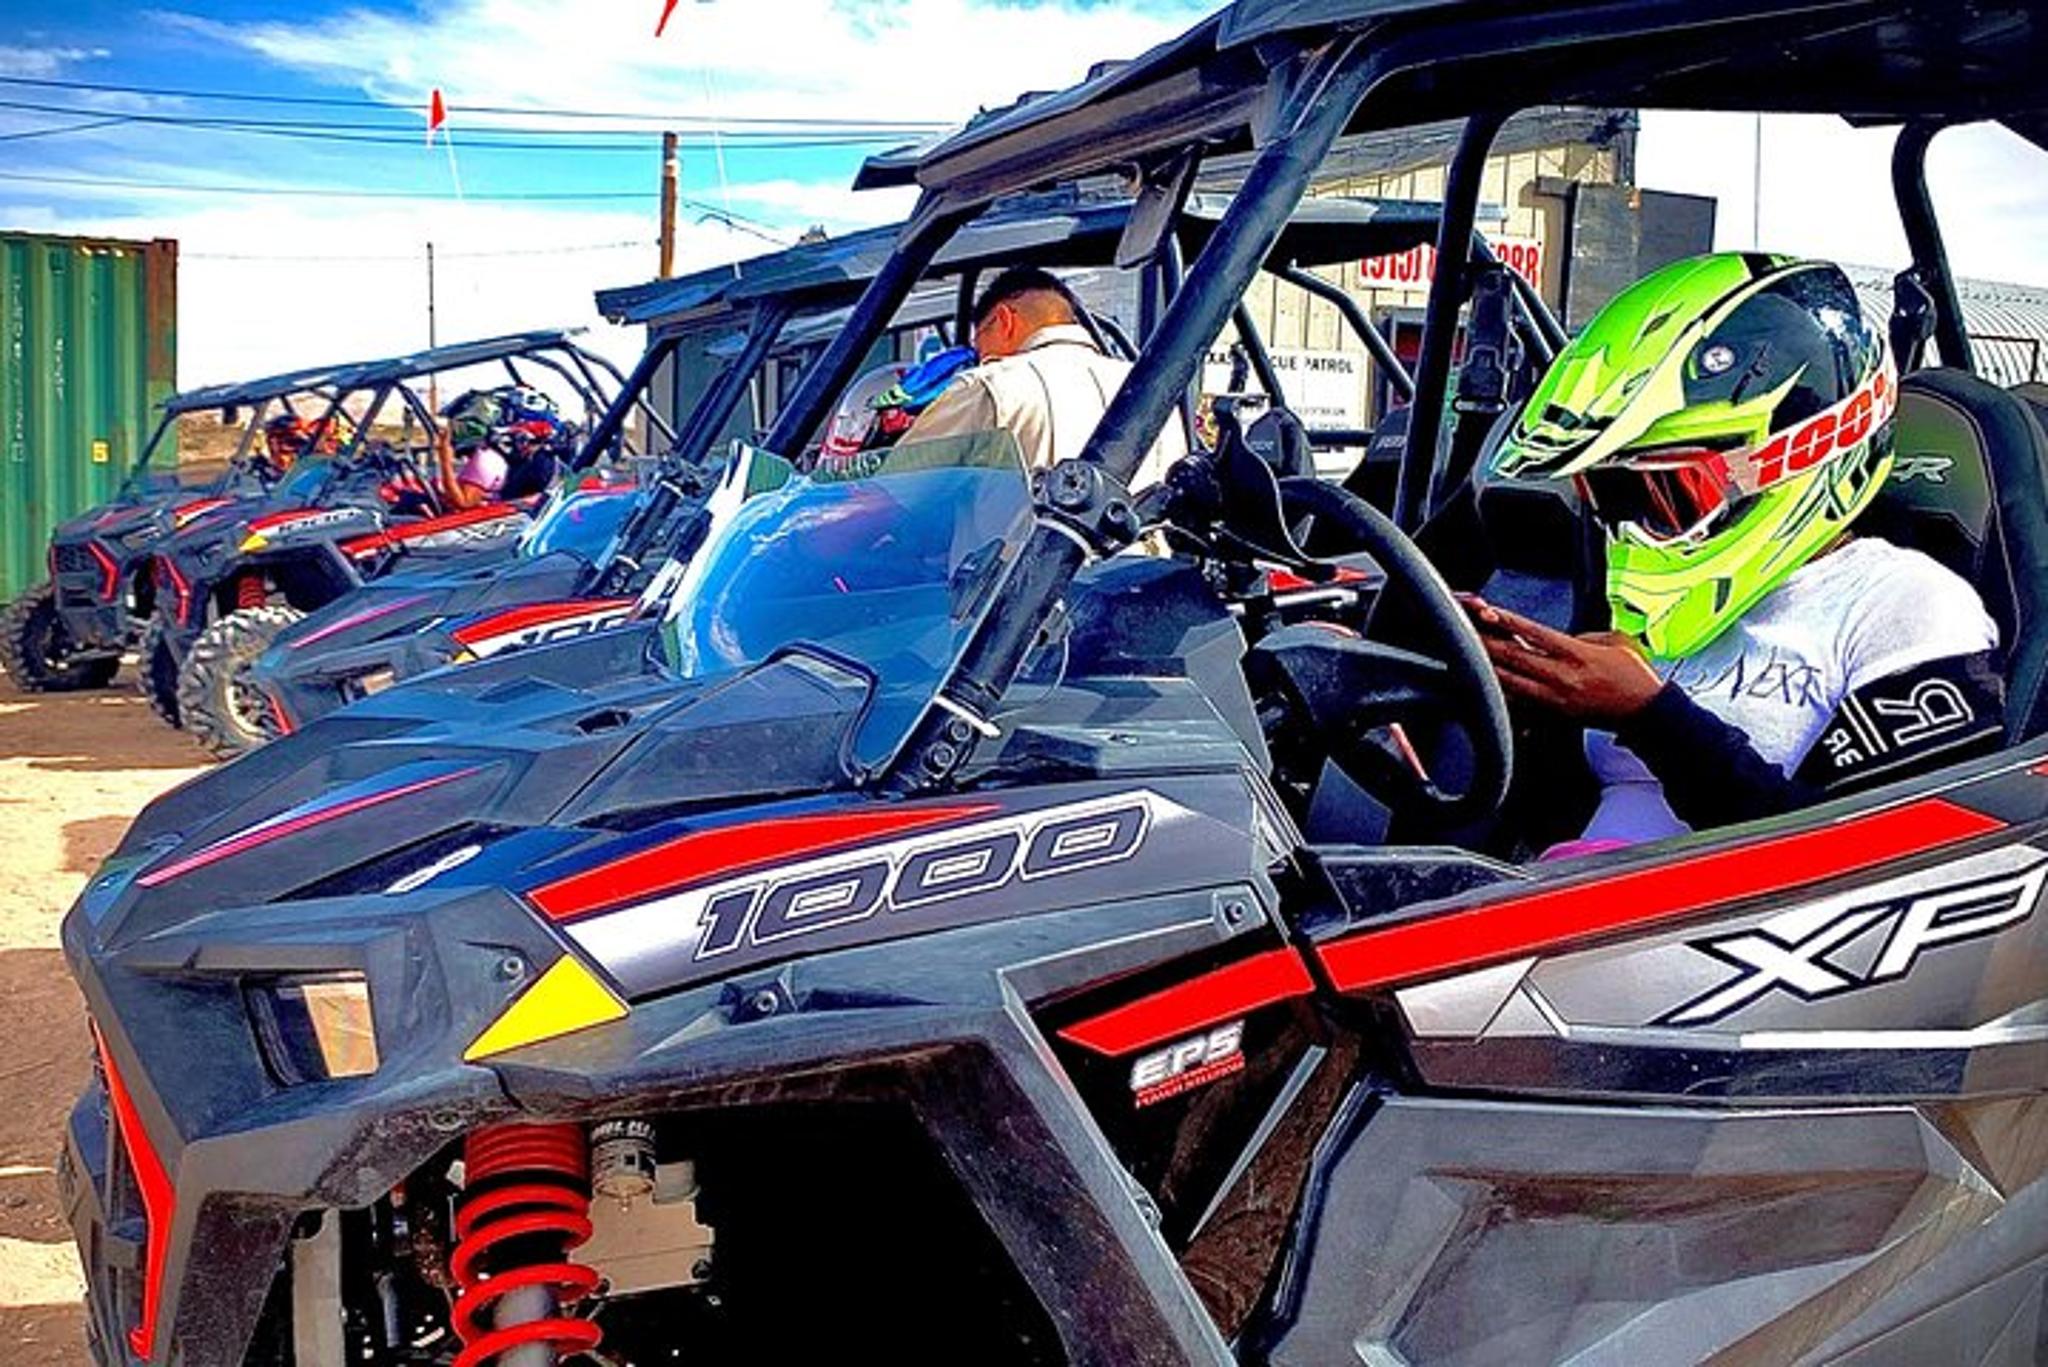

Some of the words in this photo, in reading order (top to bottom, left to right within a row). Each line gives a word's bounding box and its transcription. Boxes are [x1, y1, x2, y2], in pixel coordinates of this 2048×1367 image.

[1270, 355, 1297, 371] CUE
[694, 798, 1150, 962] 1000
[1648, 857, 2048, 1026] XP
[1130, 1020, 1245, 1091] EPS
